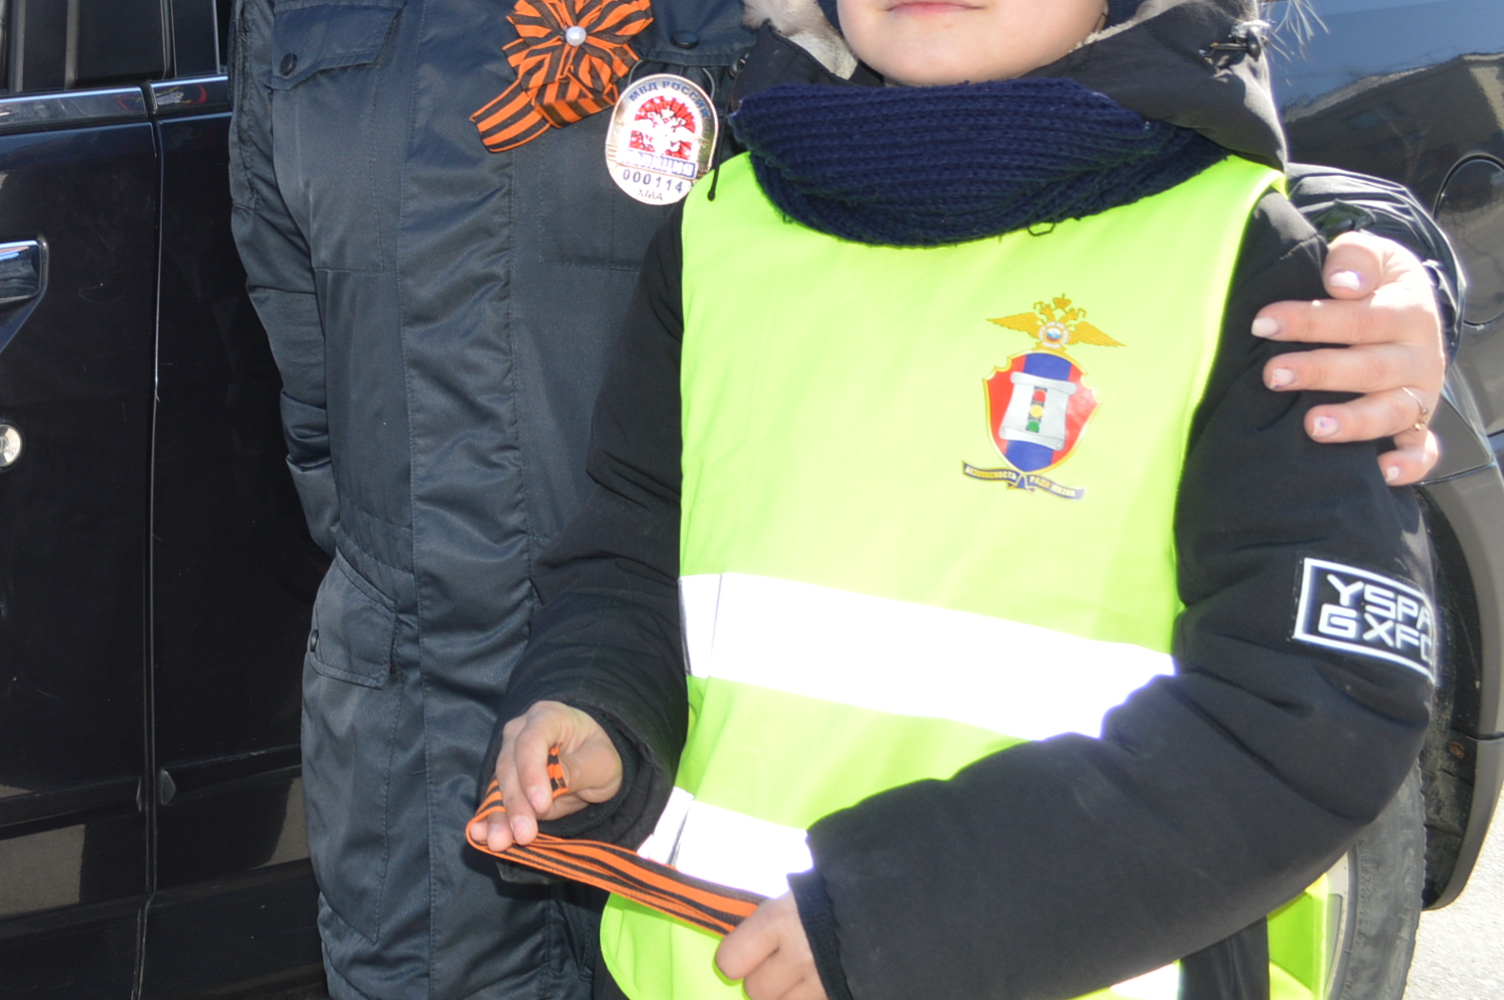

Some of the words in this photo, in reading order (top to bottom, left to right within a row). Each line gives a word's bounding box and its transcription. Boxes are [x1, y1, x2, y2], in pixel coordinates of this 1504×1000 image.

[628, 82, 659, 102] МВД
[662, 81, 711, 118] РОССИИ
[622, 168, 684, 194] 000114
